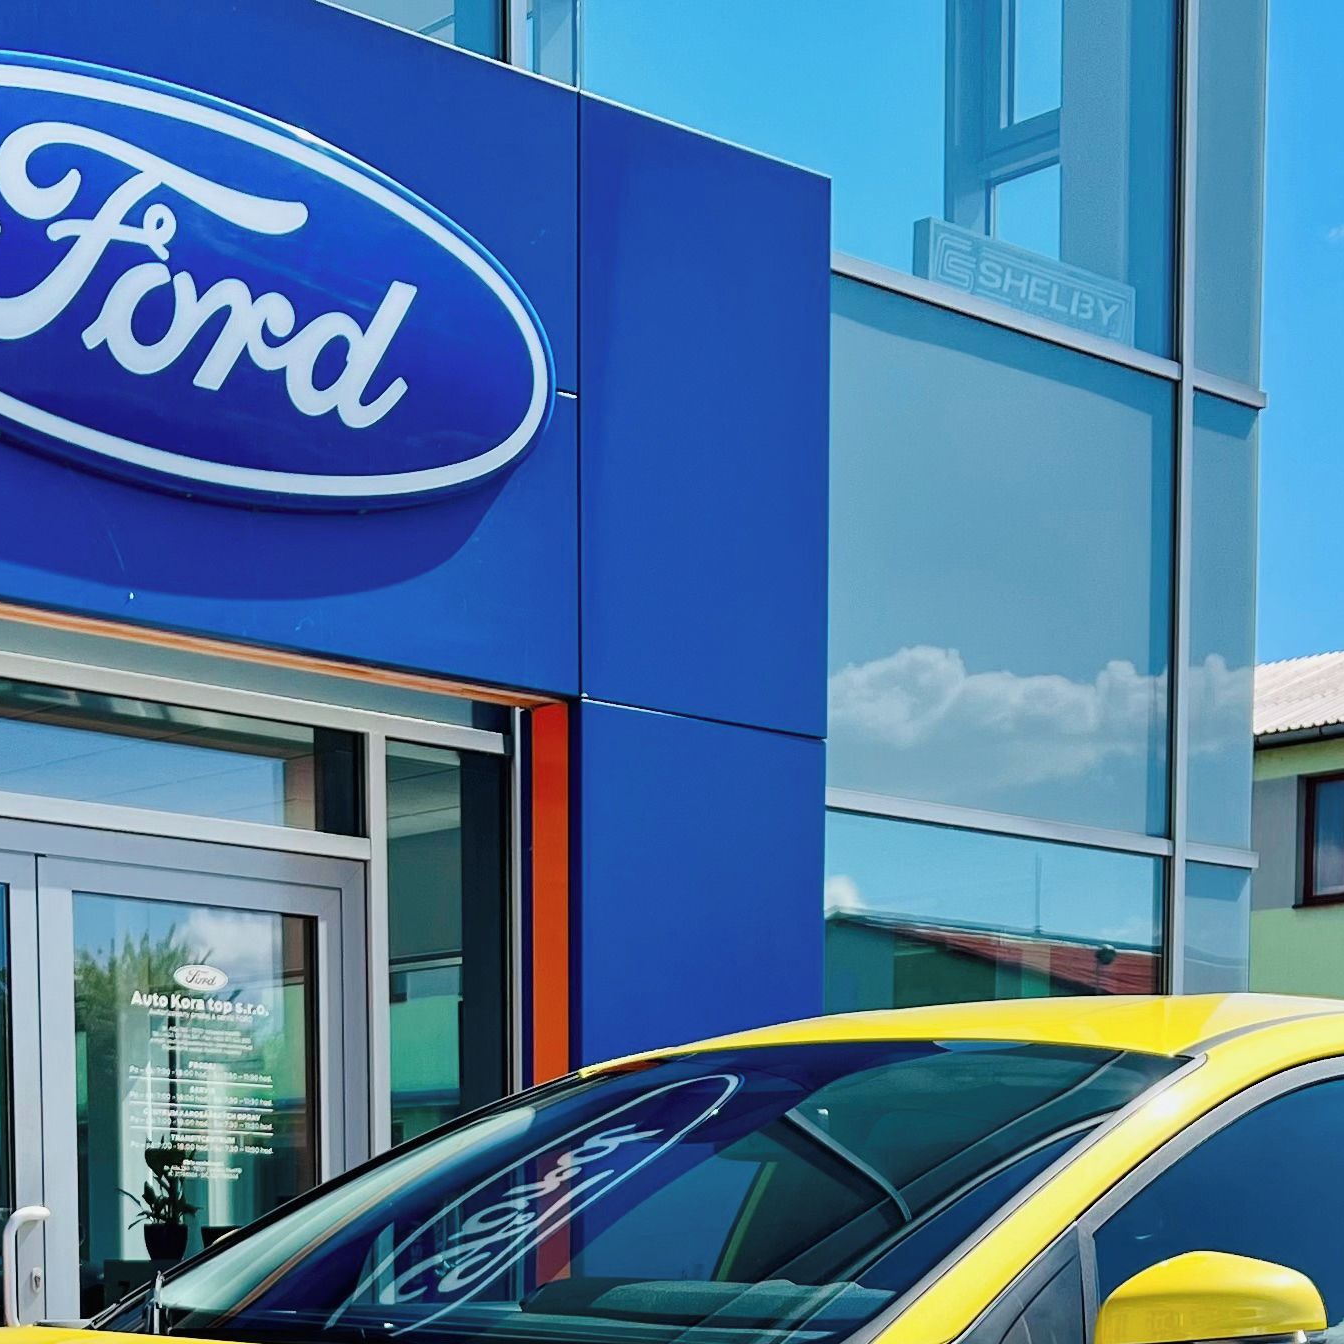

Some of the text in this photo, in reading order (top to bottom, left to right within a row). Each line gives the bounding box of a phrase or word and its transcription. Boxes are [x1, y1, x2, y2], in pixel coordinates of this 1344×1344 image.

[978, 259, 1121, 326] SHELBY
[185, 969, 216, 985] Ford
[130, 990, 169, 1009] Auto
[170, 993, 206, 1010] Kora
[208, 997, 233, 1015] top
[235, 1002, 270, 1017] s.r.o.
